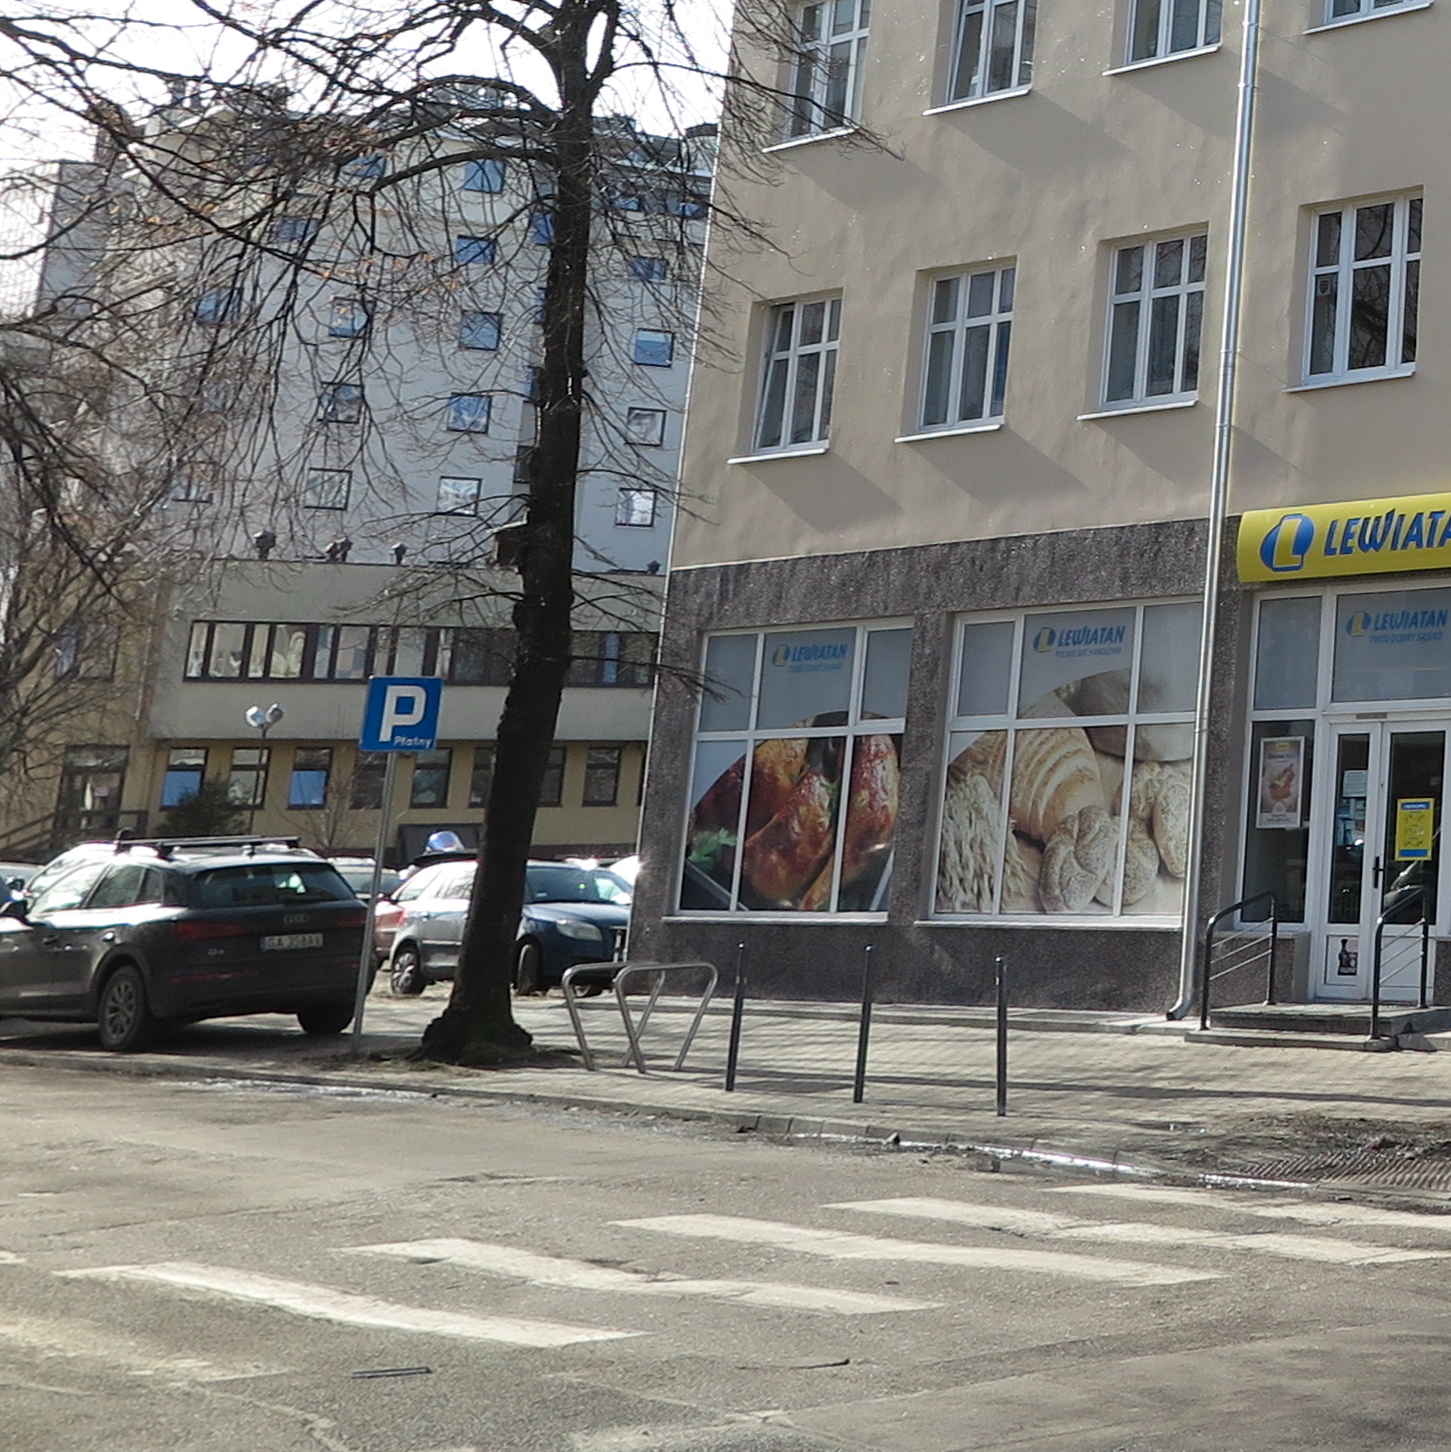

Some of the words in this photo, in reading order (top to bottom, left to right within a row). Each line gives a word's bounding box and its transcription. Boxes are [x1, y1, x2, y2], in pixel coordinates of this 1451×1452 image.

[1373, 610, 1448, 631] LEWIATAN
[1058, 626, 1125, 647] LEWIATAN
[379, 685, 426, 742] P
